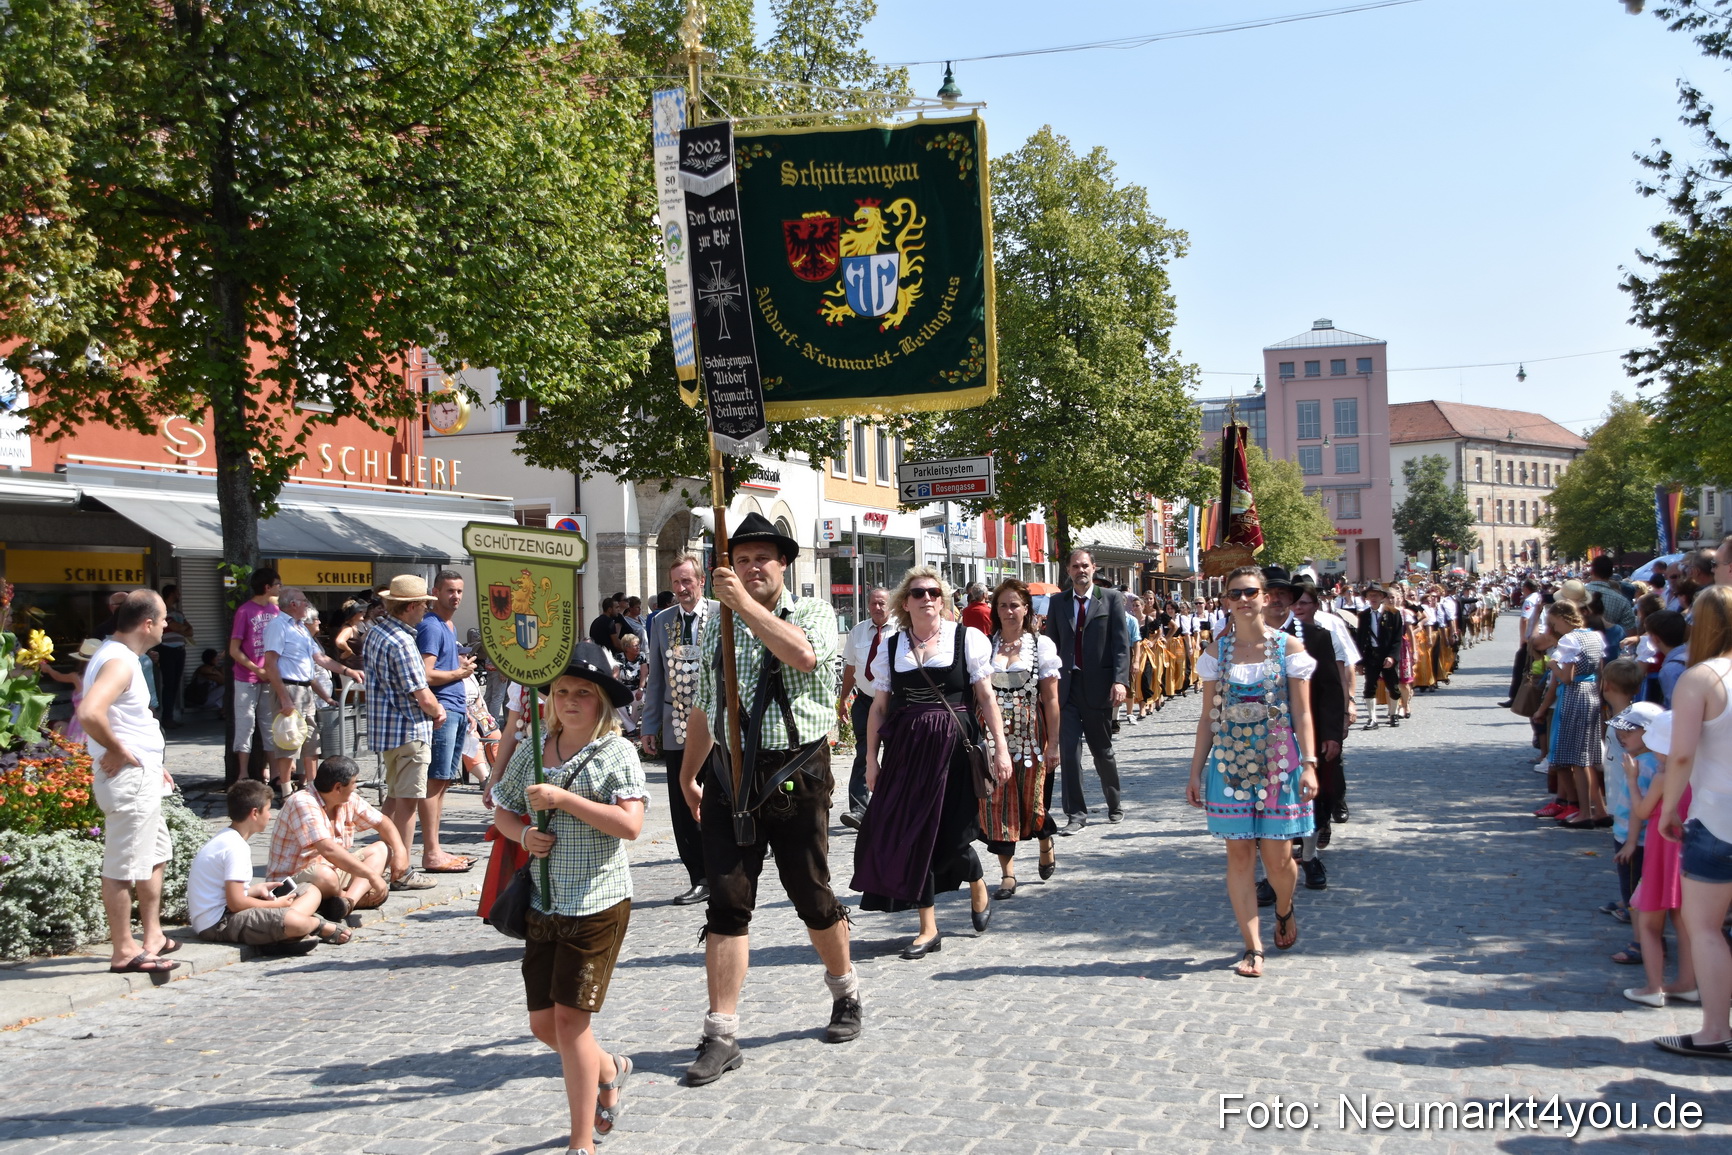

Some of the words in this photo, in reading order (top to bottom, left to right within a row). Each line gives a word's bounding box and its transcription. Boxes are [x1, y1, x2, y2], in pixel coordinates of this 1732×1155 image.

[687, 139, 722, 157] 2002
[665, 176, 676, 186] 50
[781, 159, 920, 192] Schützengau
[687, 210, 706, 227] Den
[708, 206, 736, 224] Toten
[698, 236, 711, 253] zur
[703, 354, 754, 370] Schützengau
[712, 369, 747, 386] Altdorf
[711, 387, 754, 403] Neumarkt
[318, 443, 462, 487] SCHLIERF
[913, 464, 974, 478] Parkleitsystem
[935, 482, 976, 493] Rosengasse
[474, 533, 574, 557] SCHÜTZENGAU
[64, 567, 143, 582] SCHLIERF
[317, 572, 373, 584] SCHLIERF
[480, 594, 572, 680] ALTDORF-NEUMARKT-BEILNGRIES
